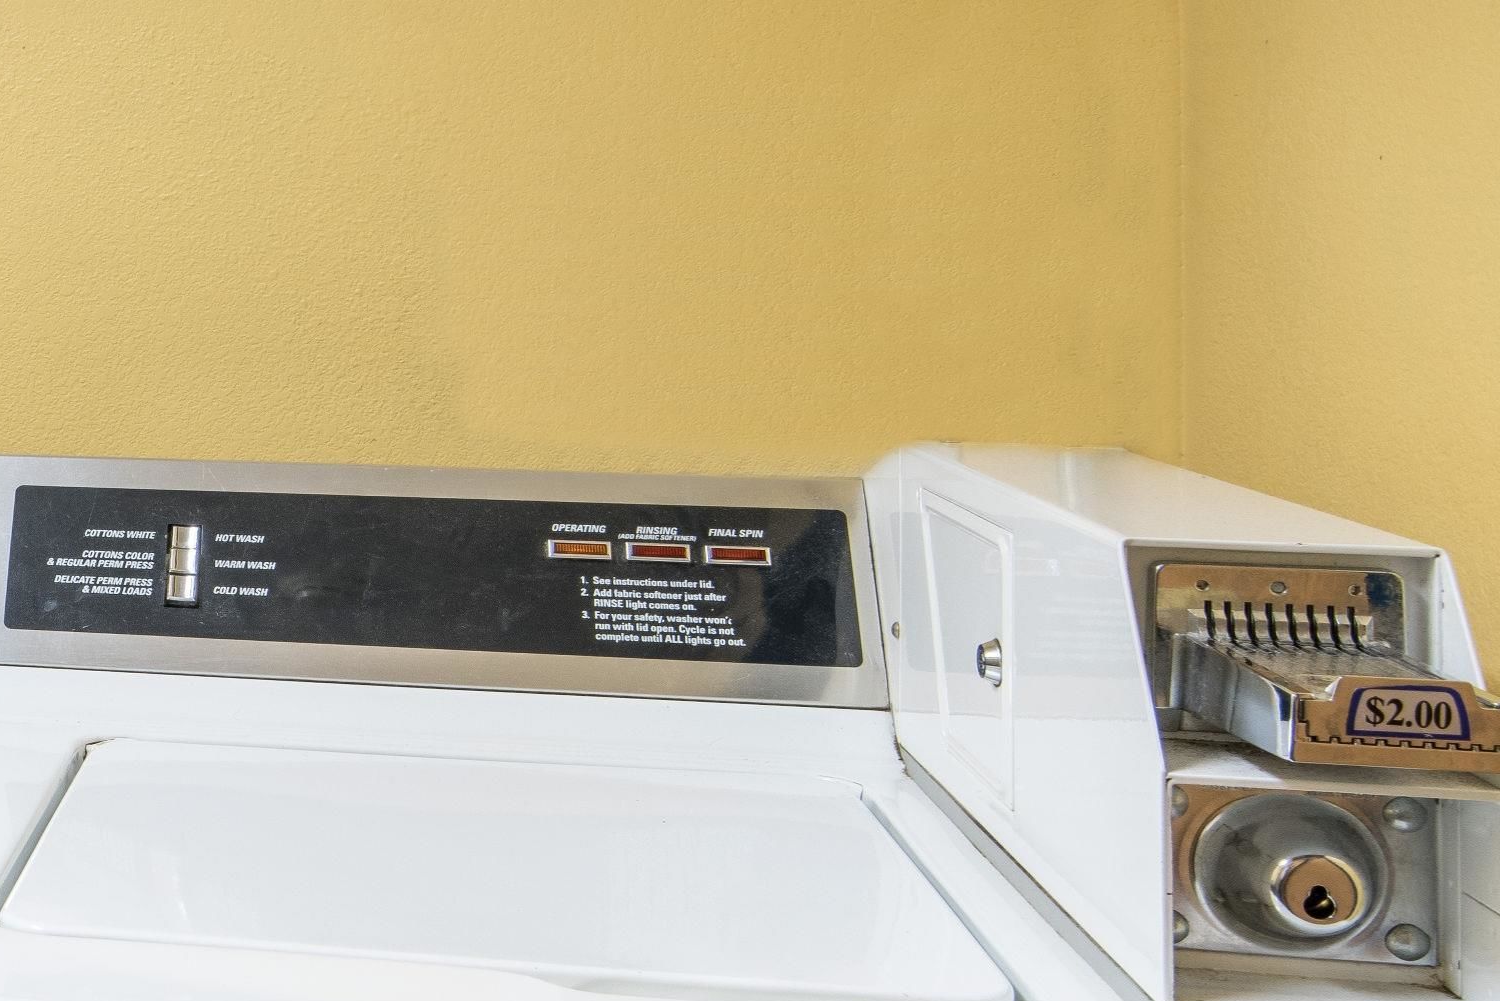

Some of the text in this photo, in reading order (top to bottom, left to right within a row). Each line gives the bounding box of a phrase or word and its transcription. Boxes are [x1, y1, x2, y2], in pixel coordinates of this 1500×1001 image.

[84, 529, 156, 539] COTTONS WHITE
[552, 524, 606, 533] OPERATING
[636, 526, 677, 535] RINSING
[708, 529, 763, 538] FINAL SPIN
[215, 534, 265, 543] HOT WASH
[659, 534, 697, 542] SOFTENER)
[82, 550, 154, 560] COTTONS COLOR
[55, 558, 96, 568] REGULAR
[97, 560, 122, 568] PERM
[123, 561, 154, 569] PRESS
[214, 560, 276, 570] WARM WASH
[54, 575, 153, 587] DELICATE PERM PRESS
[580, 576, 715, 588] 1. See instructions under lid.
[91, 585, 120, 595] MIXED
[121, 587, 153, 596] LOADS
[213, 586, 268, 596] COLD WASH
[593, 589, 612, 597] Add
[614, 589, 641, 599] fabric
[643, 590, 682, 600] softener
[684, 591, 702, 601] just
[704, 592, 727, 602] after
[594, 599, 697, 611] RINSE light comes on.
[594, 611, 610, 620] For
[611, 614, 633, 622] your
[667, 615, 703, 624] washer
[613, 623, 634, 631] with
[636, 623, 649, 632] lid
[650, 626, 677, 634] open.
[679, 625, 706, 636] Cycle
[708, 626, 717, 634] is
[719, 627, 734, 635] not
[595, 633, 746, 647] complete until ALL lights go out.
[1365, 696, 1453, 730] $2.00
